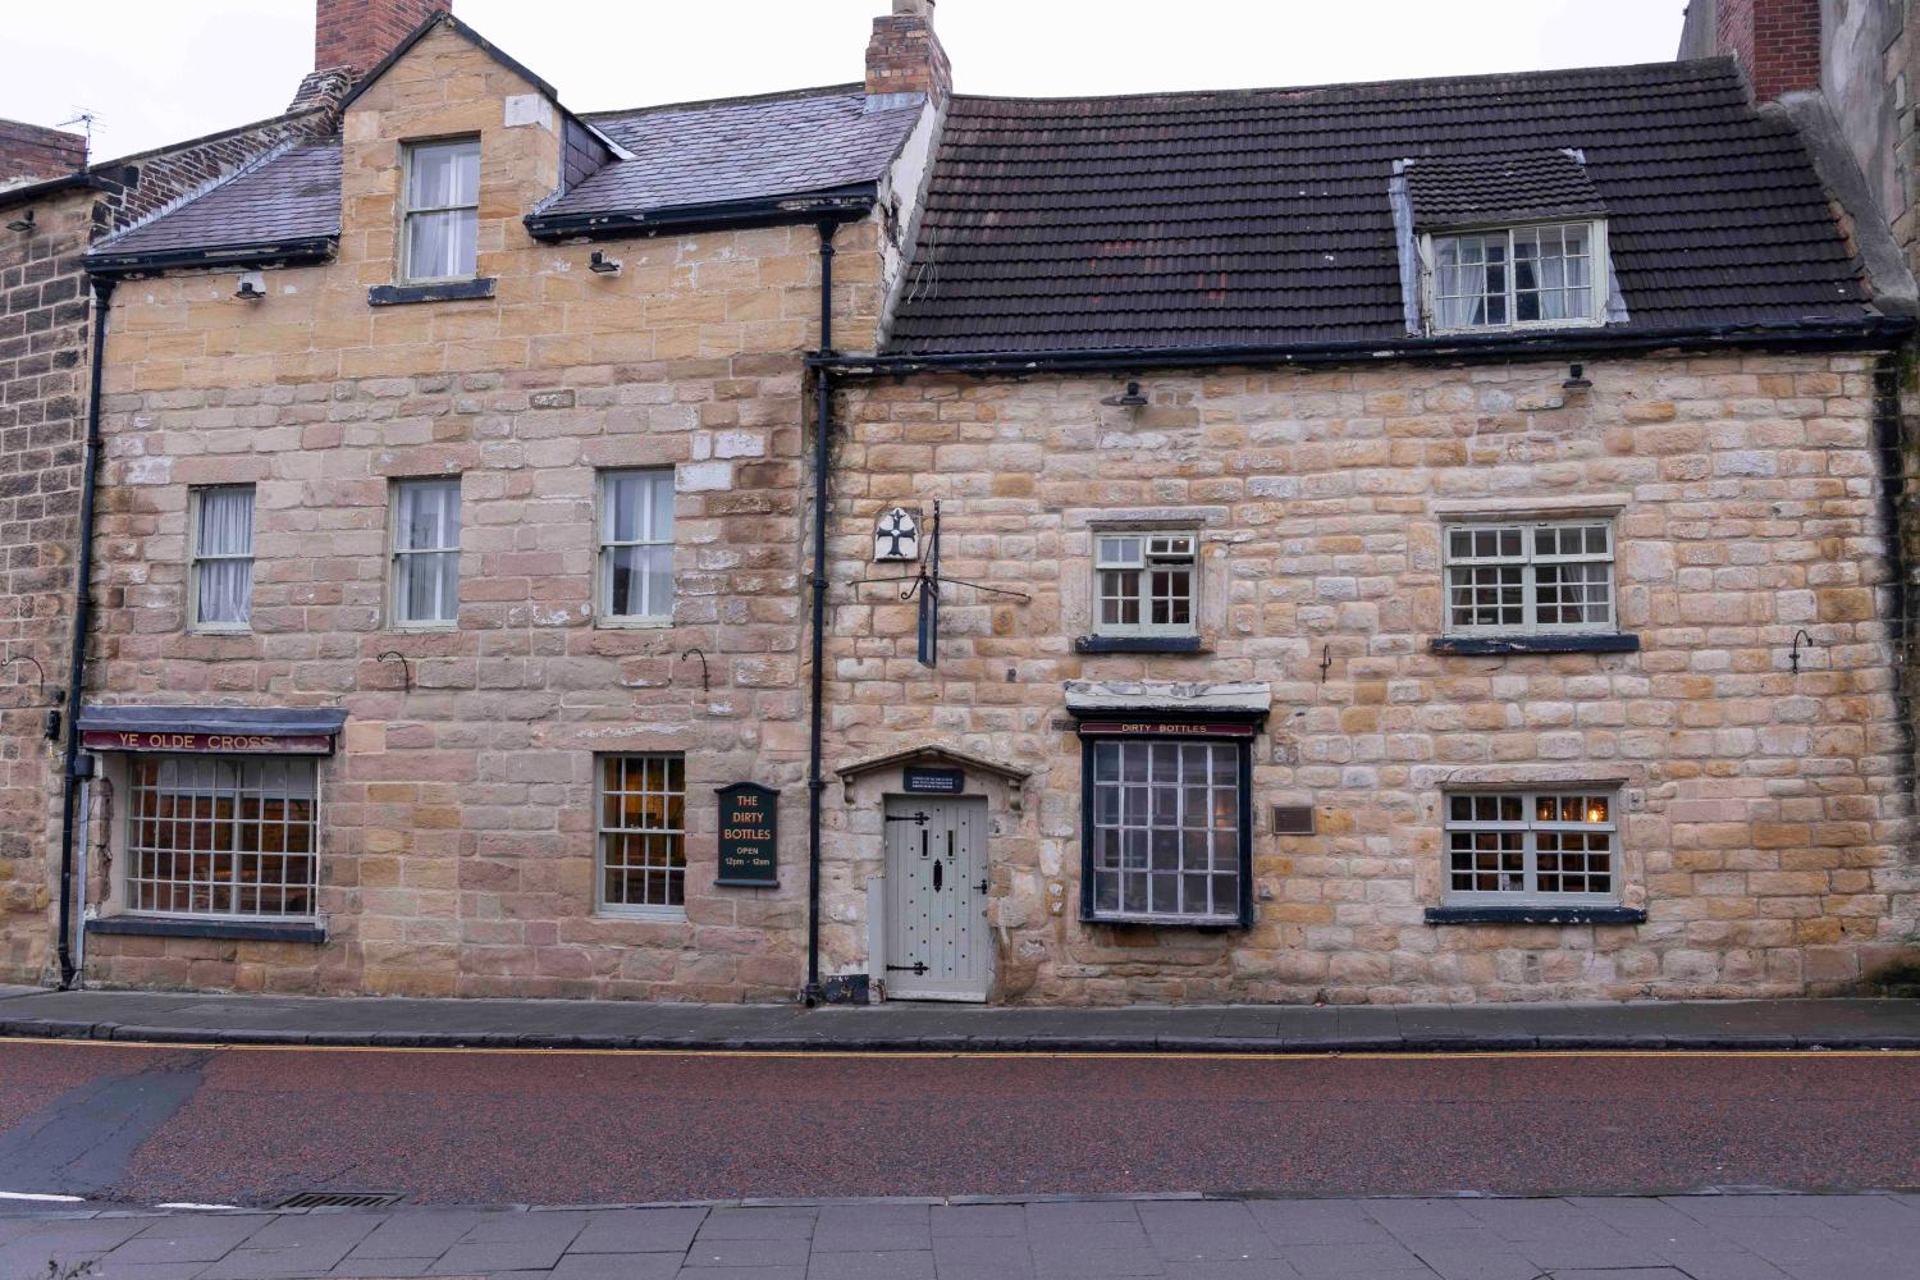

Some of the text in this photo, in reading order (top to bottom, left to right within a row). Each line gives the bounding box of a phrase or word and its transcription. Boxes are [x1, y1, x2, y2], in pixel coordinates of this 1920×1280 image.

[1121, 723, 1207, 734] DIRTY BOTTLES
[120, 733, 274, 751] YE OLDE CROSS
[736, 795, 759, 806] THE
[732, 812, 764, 823] DIRTY
[724, 828, 771, 840] BOTTLES
[736, 847, 759, 855] OPEN
[725, 857, 745, 868] 12pm
